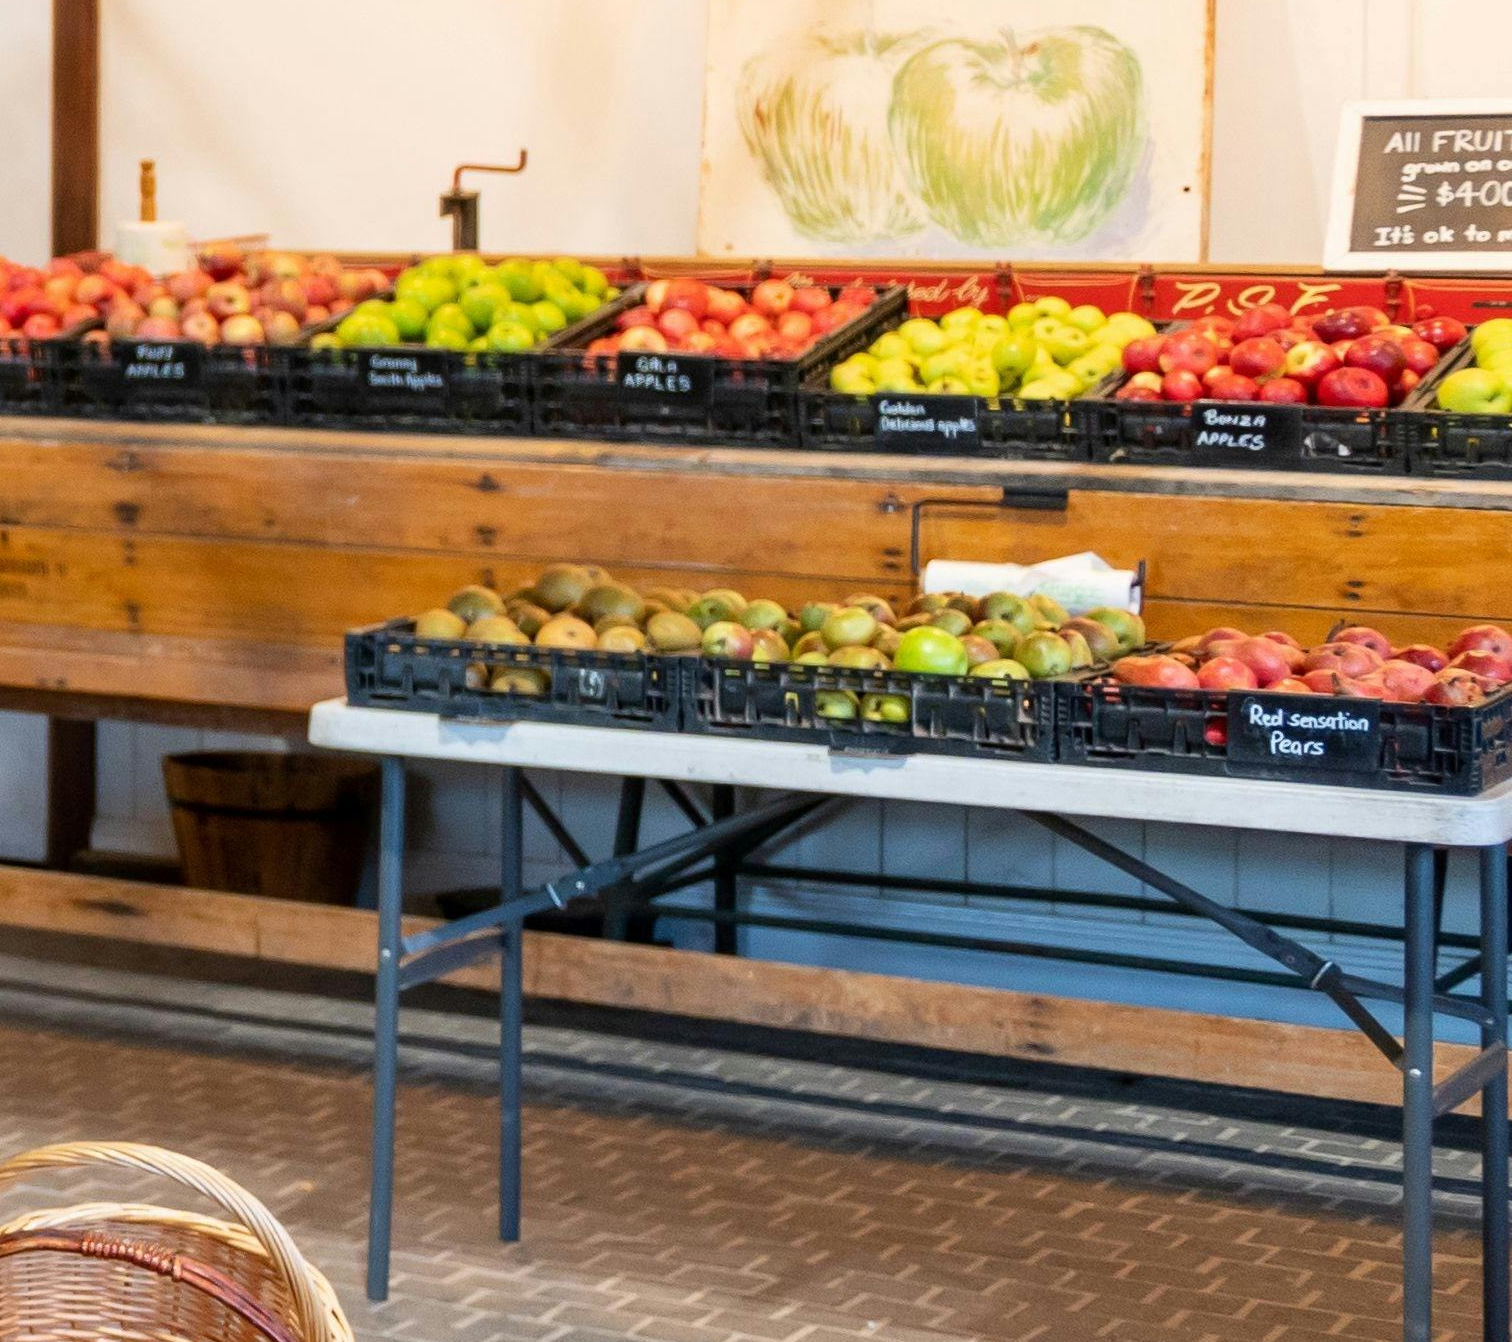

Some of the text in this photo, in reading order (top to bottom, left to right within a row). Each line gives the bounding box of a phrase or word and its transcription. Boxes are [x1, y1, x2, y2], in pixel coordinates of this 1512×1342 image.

[1464, 159, 1493, 173] on
[1422, 225, 1455, 244] ok
[1463, 223, 1492, 243] to
[623, 373, 692, 393] APPLES
[1195, 430, 1265, 451] APPLES
[1249, 704, 1370, 732] Red sensation
[1270, 730, 1325, 756] Pears
